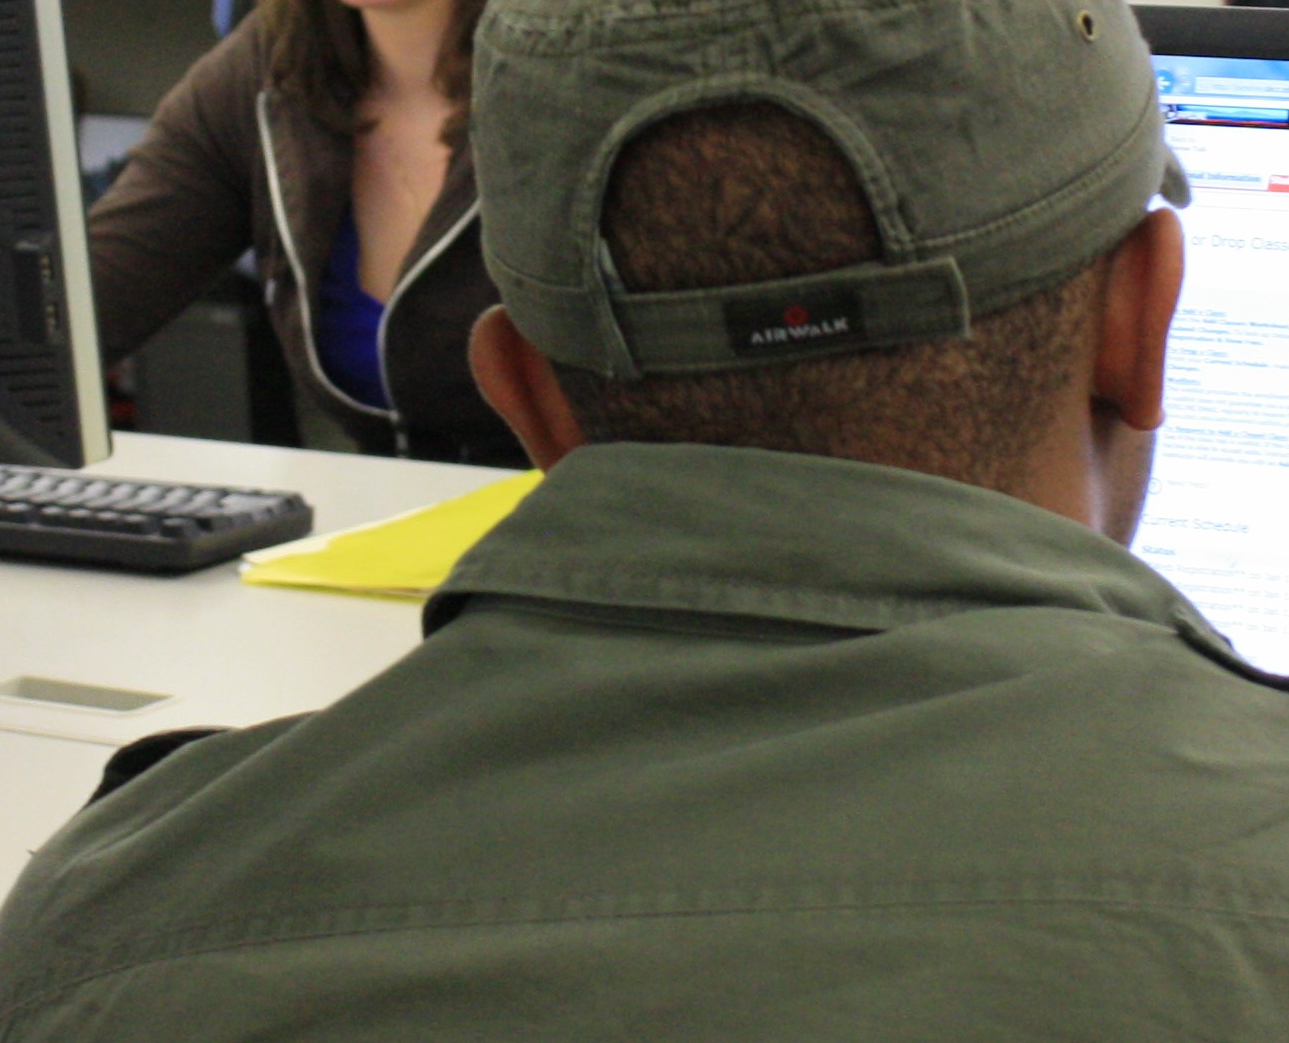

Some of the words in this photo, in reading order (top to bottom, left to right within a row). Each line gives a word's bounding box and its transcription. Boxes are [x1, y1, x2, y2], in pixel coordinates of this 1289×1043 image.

[1211, 234, 1246, 251] Drop
[750, 317, 849, 344] AIRWALK
[1193, 517, 1250, 534] Schedule
